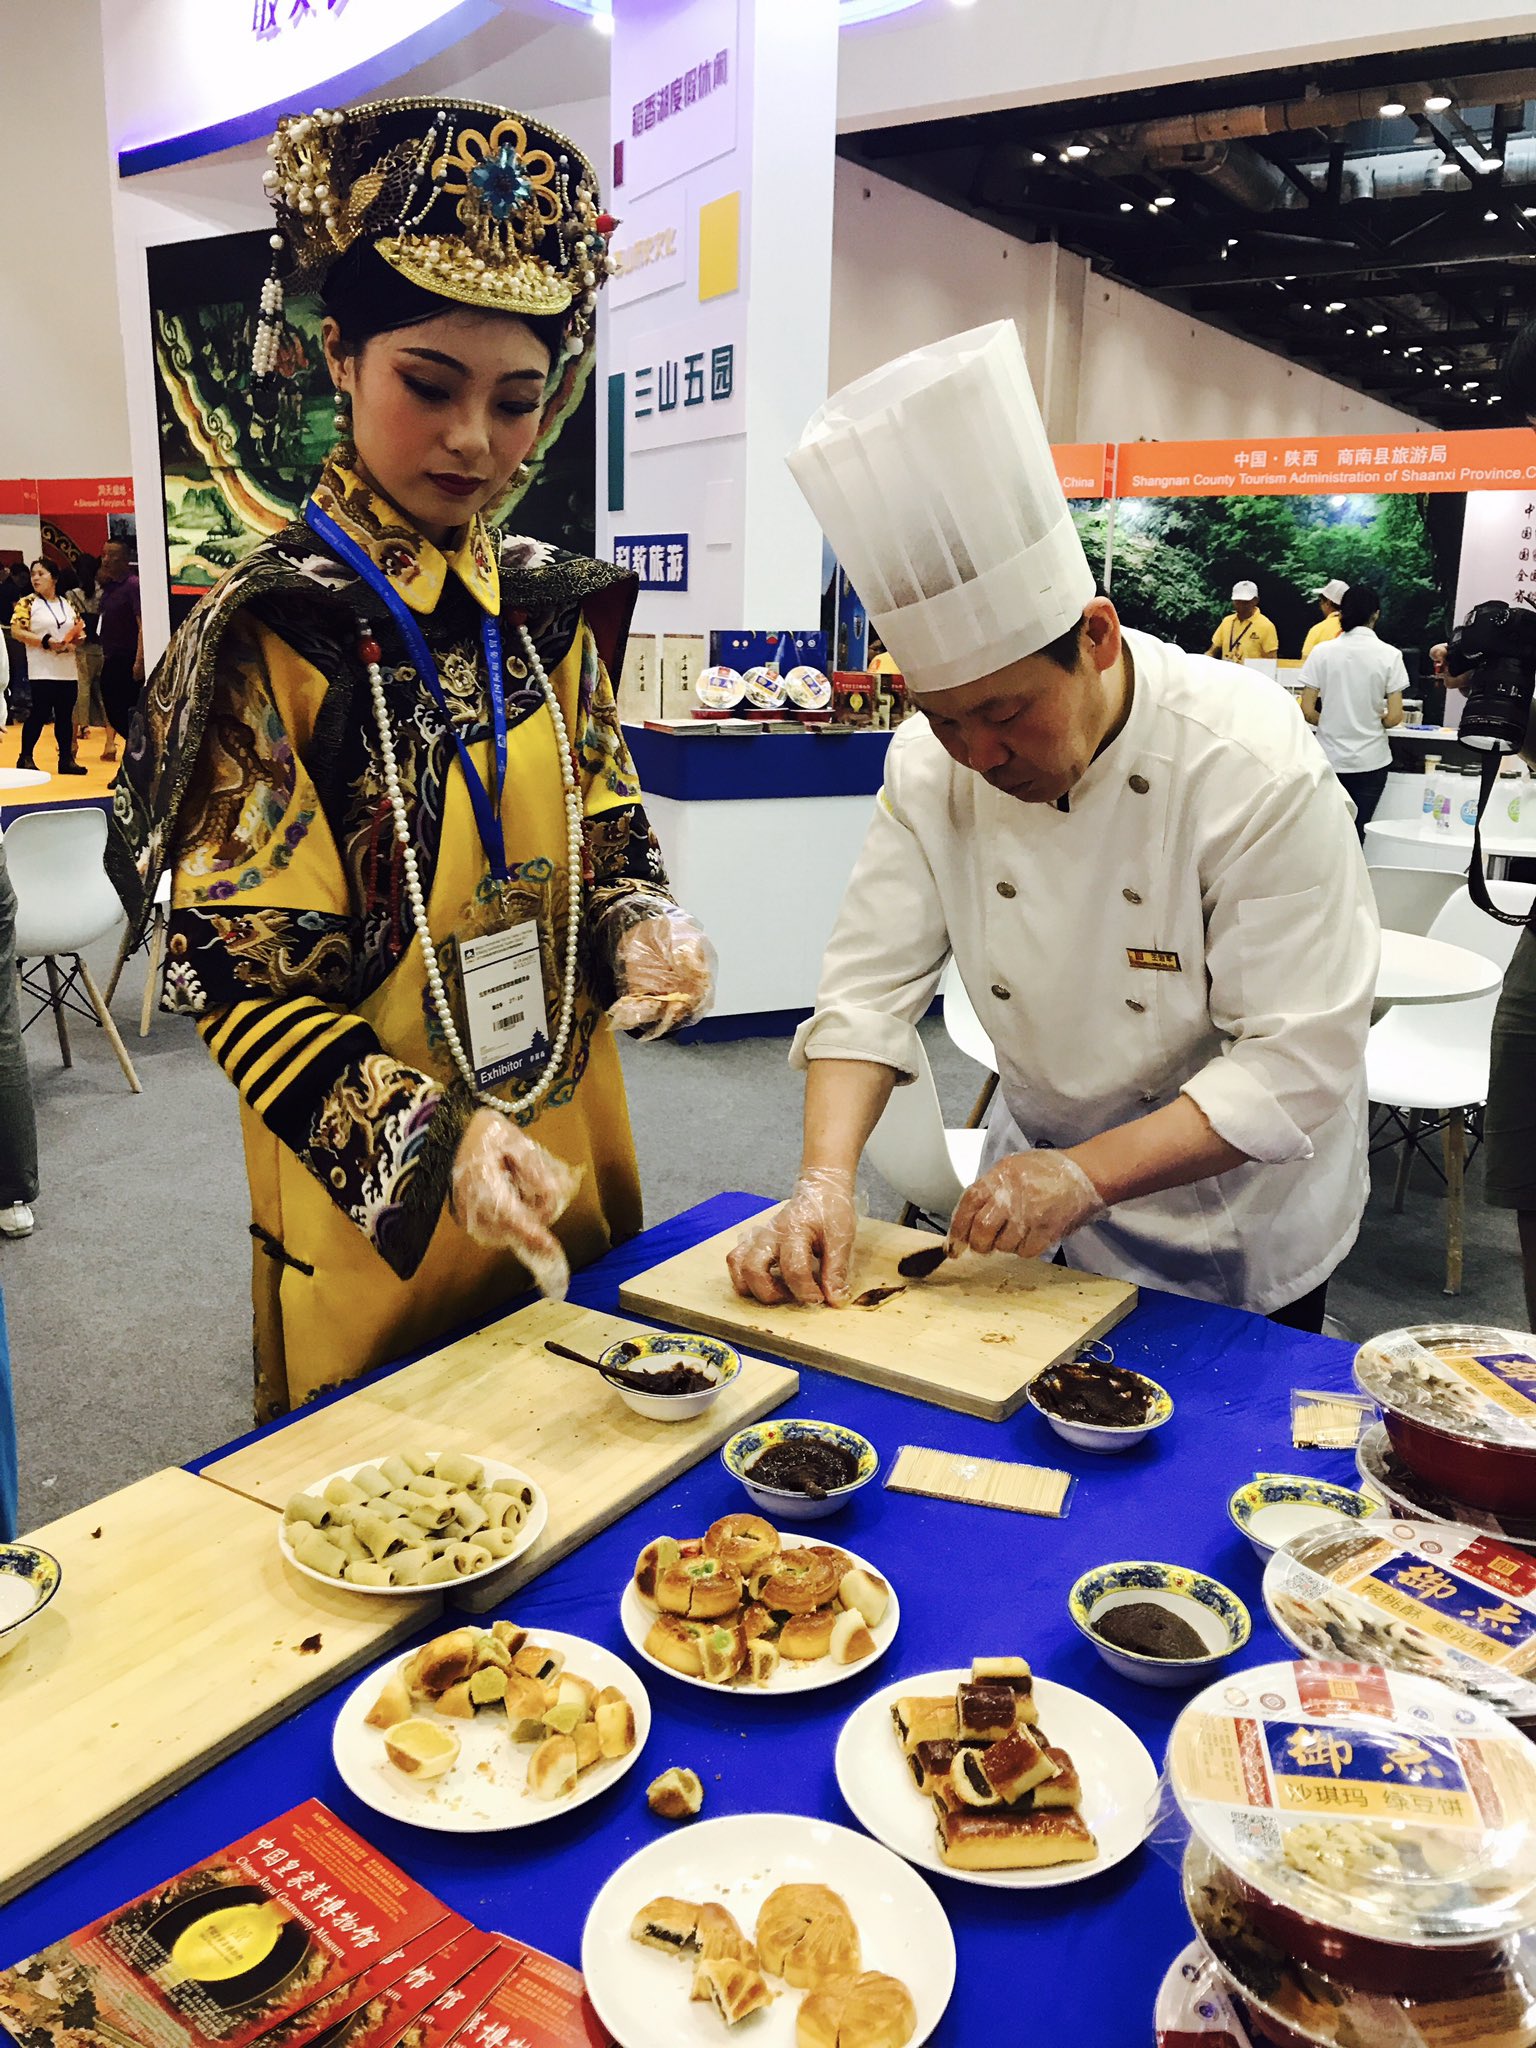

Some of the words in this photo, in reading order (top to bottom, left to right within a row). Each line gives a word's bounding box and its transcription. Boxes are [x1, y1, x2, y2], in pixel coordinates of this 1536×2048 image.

[632, 48, 728, 138] 稻香湖度假休闲
[635, 344, 733, 418] 三山五园
[1063, 476, 1095, 488] China
[1132, 474, 1190, 489] Shangnan
[1193, 473, 1235, 488] County
[1239, 472, 1287, 486] Tourism
[1289, 470, 1380, 485] Administration
[1384, 469, 1399, 482] of
[1401, 467, 1456, 482] Shaanxi
[1234, 449, 1319, 468] 中国·陕西
[1337, 445, 1447, 466] 商南县旅游局
[480, 1058, 523, 1084] Exhibitor
[1361, 1582, 1426, 1621] 核桃酥
[1432, 1619, 1495, 1657] 枣泥酥
[1288, 1784, 1369, 1808] 沙琪玛
[1383, 1790, 1463, 1817] 绿豆饼
[236, 1856, 260, 1880] Chinese
[258, 1875, 278, 1896] Royal
[276, 1891, 317, 1931] Gastronomy
[313, 1926, 345, 1959] Museum
[249, 1837, 381, 1949] 中国皇家菜博物馆
